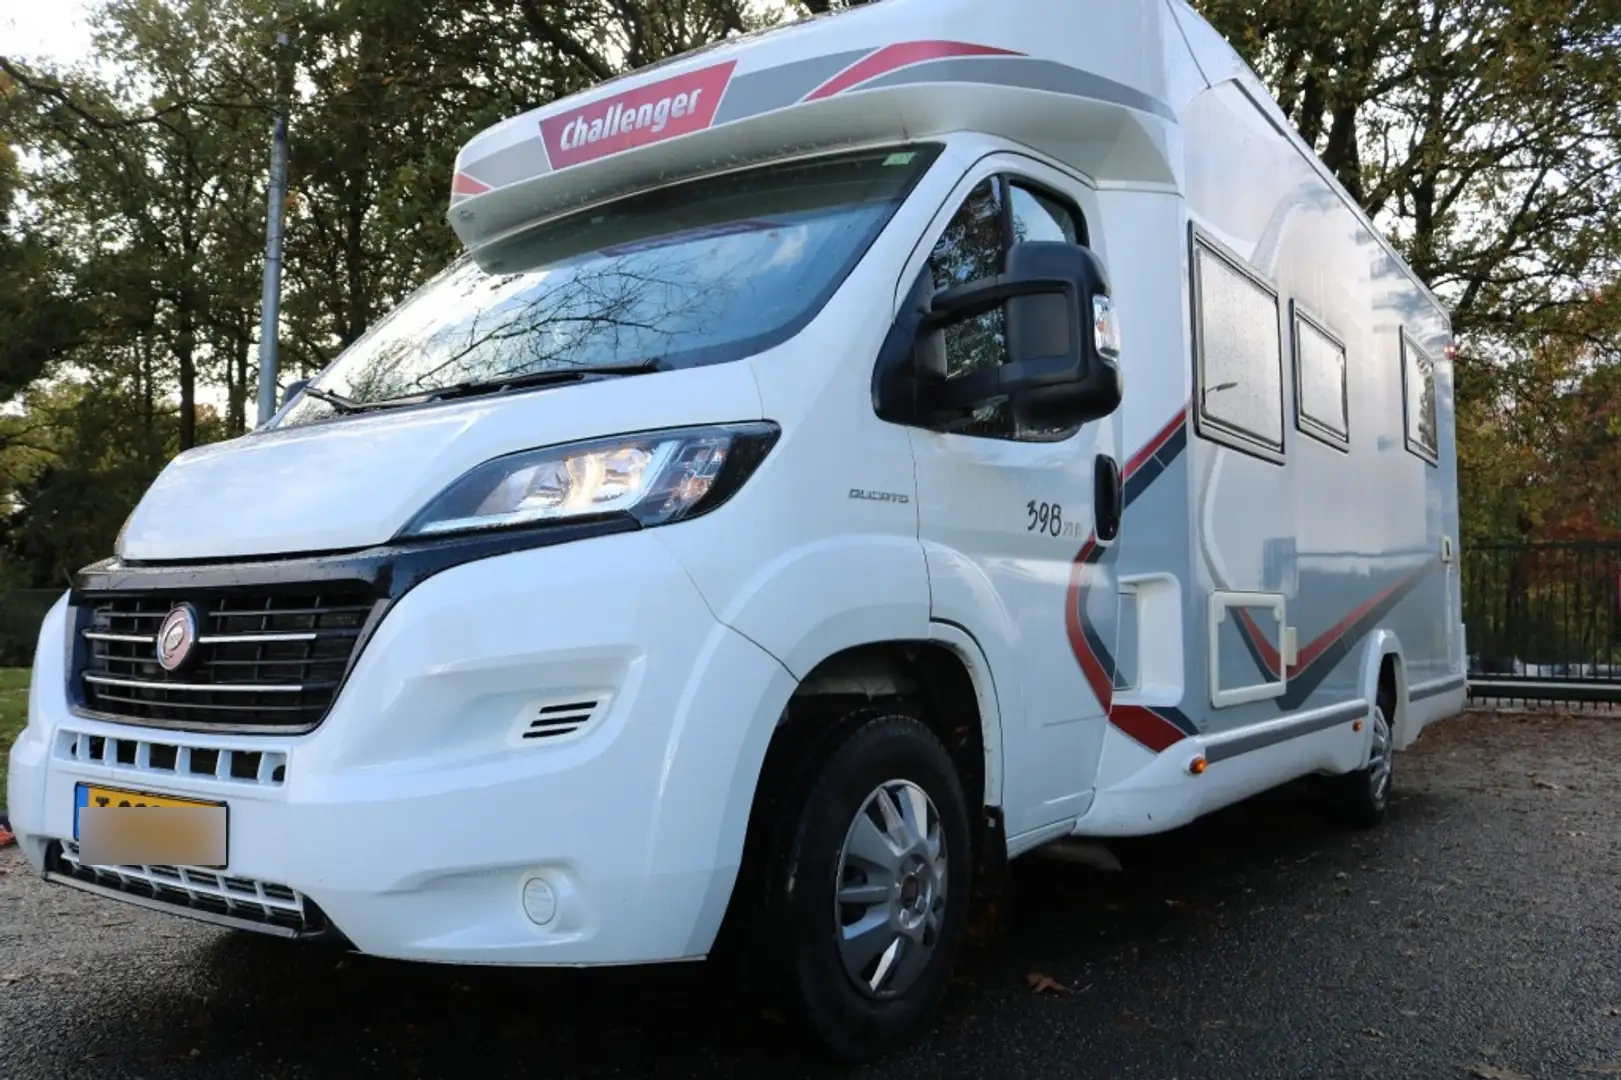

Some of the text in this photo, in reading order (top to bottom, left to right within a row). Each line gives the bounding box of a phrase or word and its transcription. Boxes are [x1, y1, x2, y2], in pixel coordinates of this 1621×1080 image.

[560, 88, 702, 151] Challenger
[848, 488, 909, 504] DUCATO
[1026, 499, 1062, 537] 398
